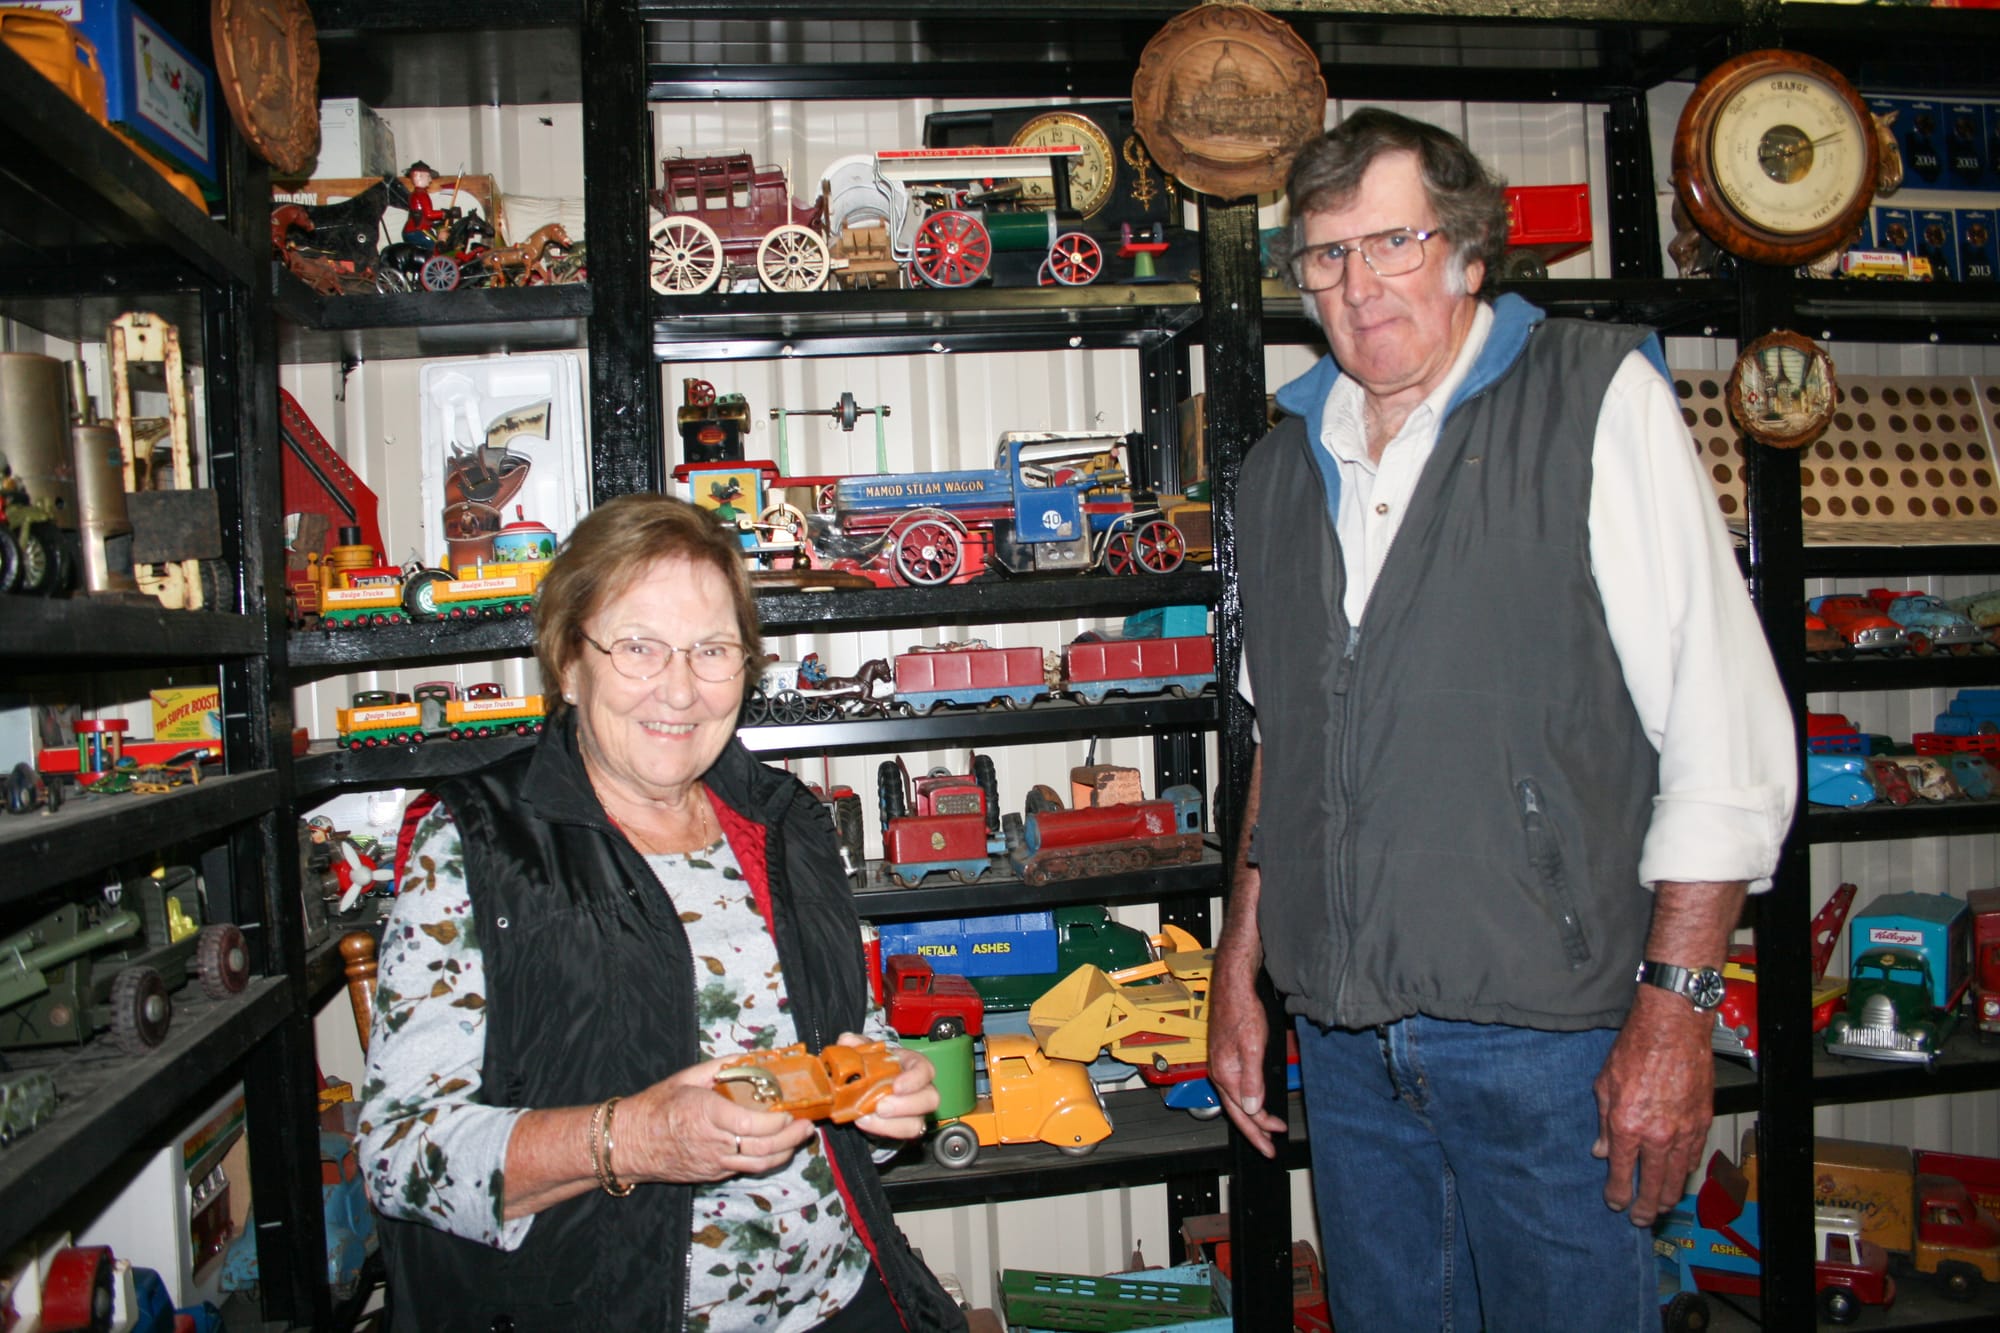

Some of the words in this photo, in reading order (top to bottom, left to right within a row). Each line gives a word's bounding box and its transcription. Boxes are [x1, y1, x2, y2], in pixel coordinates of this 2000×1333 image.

[1770, 81, 1809, 95] CHANGE
[906, 149, 950, 158] MAMOD
[1913, 156, 1937, 168] 2004
[1956, 158, 1979, 169] 2003
[273, 191, 318, 206] WAGON
[1724, 182, 1751, 213] STORMY
[1812, 204, 1831, 221] VERY
[1968, 264, 1992, 277] 2013
[866, 485, 903, 497] MAMOD
[944, 480, 984, 493] WAGON
[1043, 513, 1060, 529] 40
[462, 582, 482, 590] Dodge
[484, 579, 505, 587] Trucks
[341, 590, 361, 598] Dodge
[362, 589, 384, 597] Trucks
[472, 702, 493, 710] Dodge
[494, 700, 515, 708] Trucks
[168, 704, 190, 725] SUPER
[365, 713, 385, 721] Dodge
[386, 710, 406, 718] Trucks
[1875, 931, 1916, 943] Kellogg's
[918, 946, 957, 956] METAL&
[973, 943, 1011, 954] ASHES
[1711, 1243, 1748, 1257] ASHE
